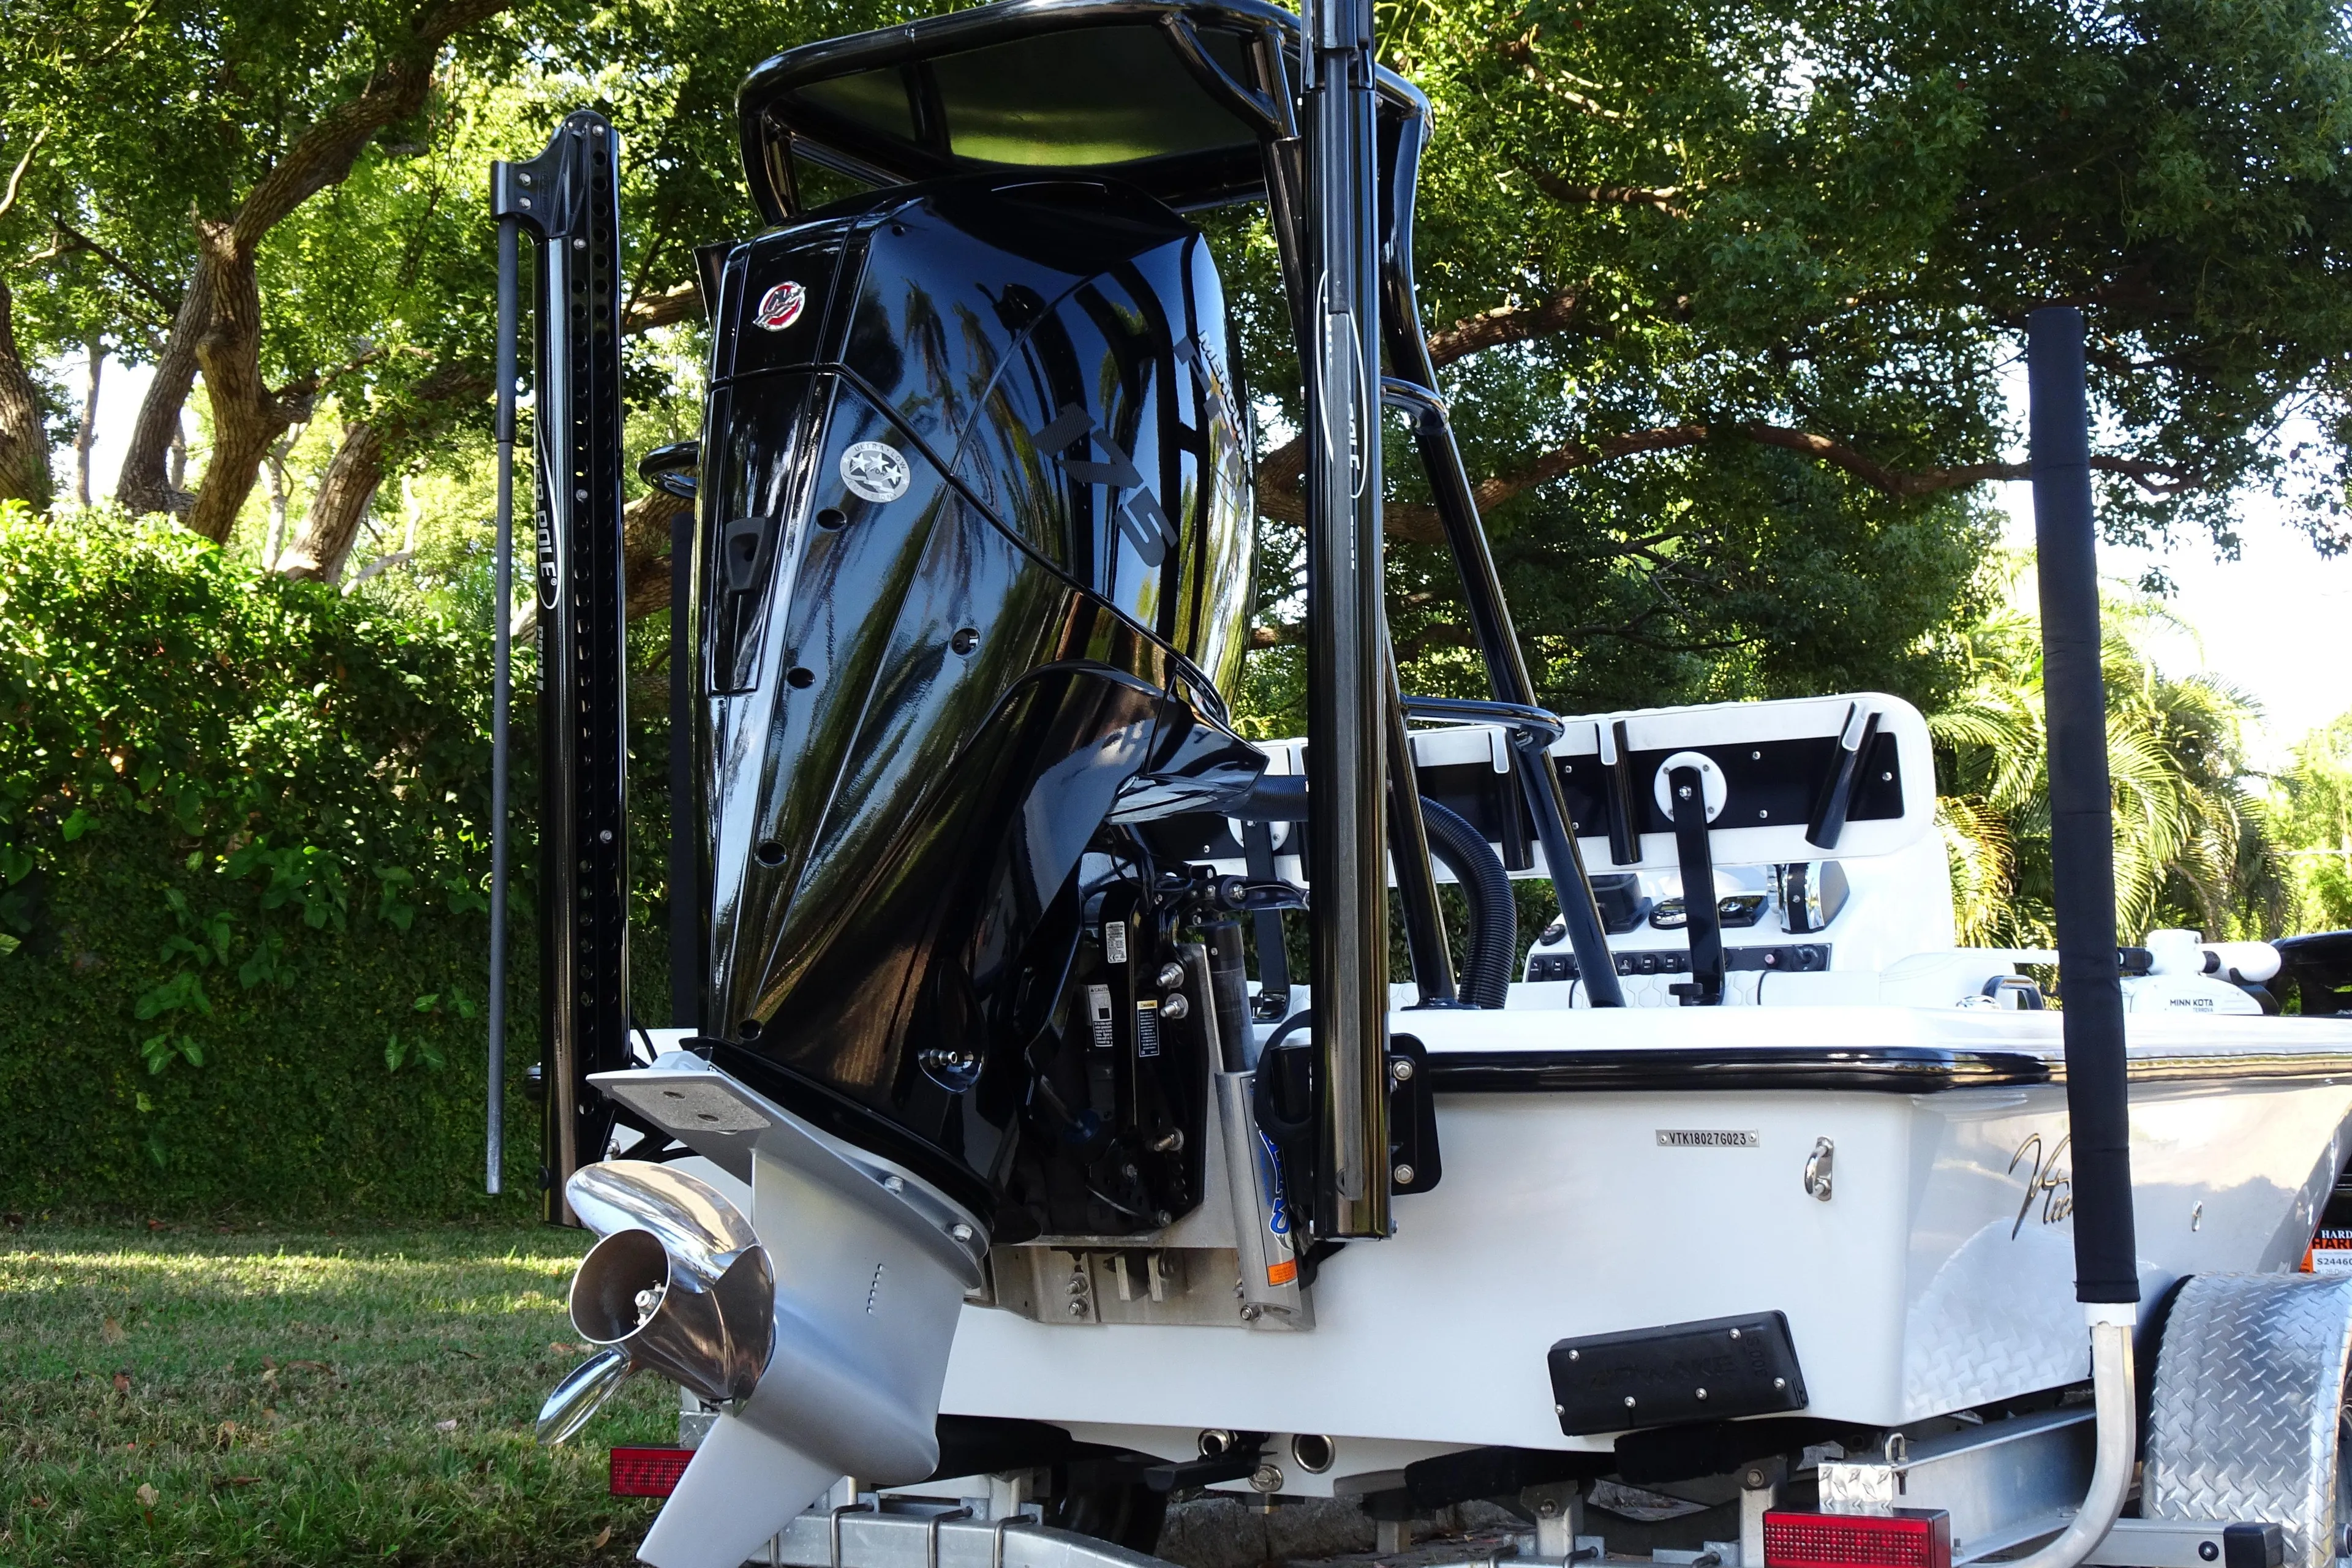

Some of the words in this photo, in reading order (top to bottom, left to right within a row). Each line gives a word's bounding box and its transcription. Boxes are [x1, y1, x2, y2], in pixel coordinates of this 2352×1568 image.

[854, 443, 884, 452] ULTRA
[891, 452, 907, 470] LOW
[1031, 402, 1179, 568] 175
[1669, 1133, 1746, 1145] VTK18027G023
